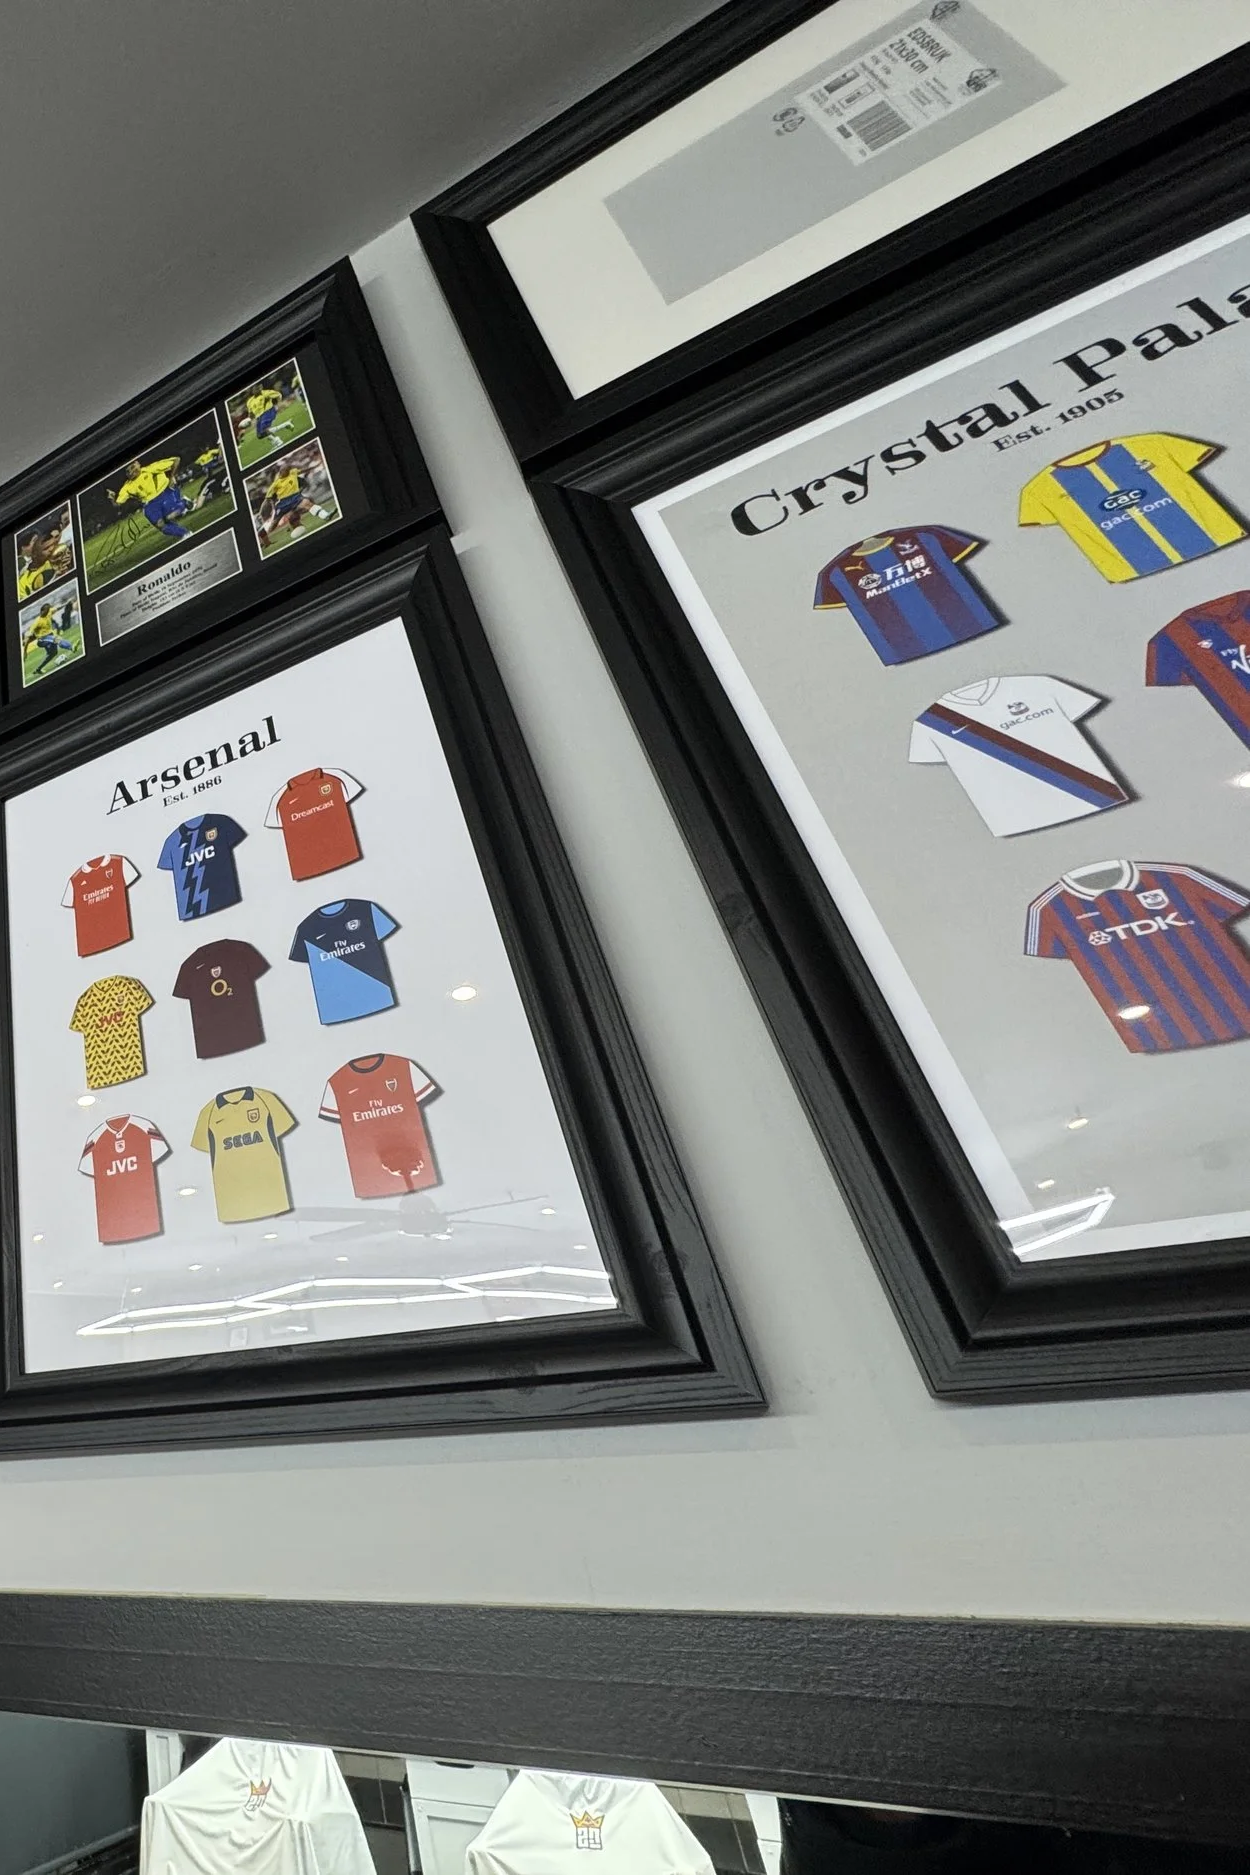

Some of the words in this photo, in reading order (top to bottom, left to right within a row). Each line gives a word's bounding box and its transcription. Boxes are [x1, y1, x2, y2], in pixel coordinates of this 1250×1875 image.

[889, 38, 919, 62] 21x30
[910, 59, 929, 74] cm
[907, 27, 952, 63] EDSBRUK
[990, 422, 1051, 453] Est.
[1058, 387, 1126, 425] 1905
[729, 377, 1052, 536] Crystal
[136, 561, 191, 596] Ronaldo
[865, 567, 932, 599] ManBetX
[999, 707, 1054, 731] gac.com
[106, 715, 282, 816] Arsenal
[162, 785, 189, 808] Est.
[193, 775, 223, 794] 1886
[290, 799, 335, 822] Dreamcast
[185, 845, 215, 867] JVC
[82, 884, 114, 901] Emirates
[1105, 912, 1189, 942] TDK
[319, 940, 366, 962] Emirates
[334, 940, 348, 950] Fly
[95, 1011, 124, 1029] JVC
[352, 1102, 404, 1123] Emirates
[368, 1099, 383, 1110] Fly
[223, 1131, 264, 1151] SEGA
[106, 1156, 139, 1177] JVC
